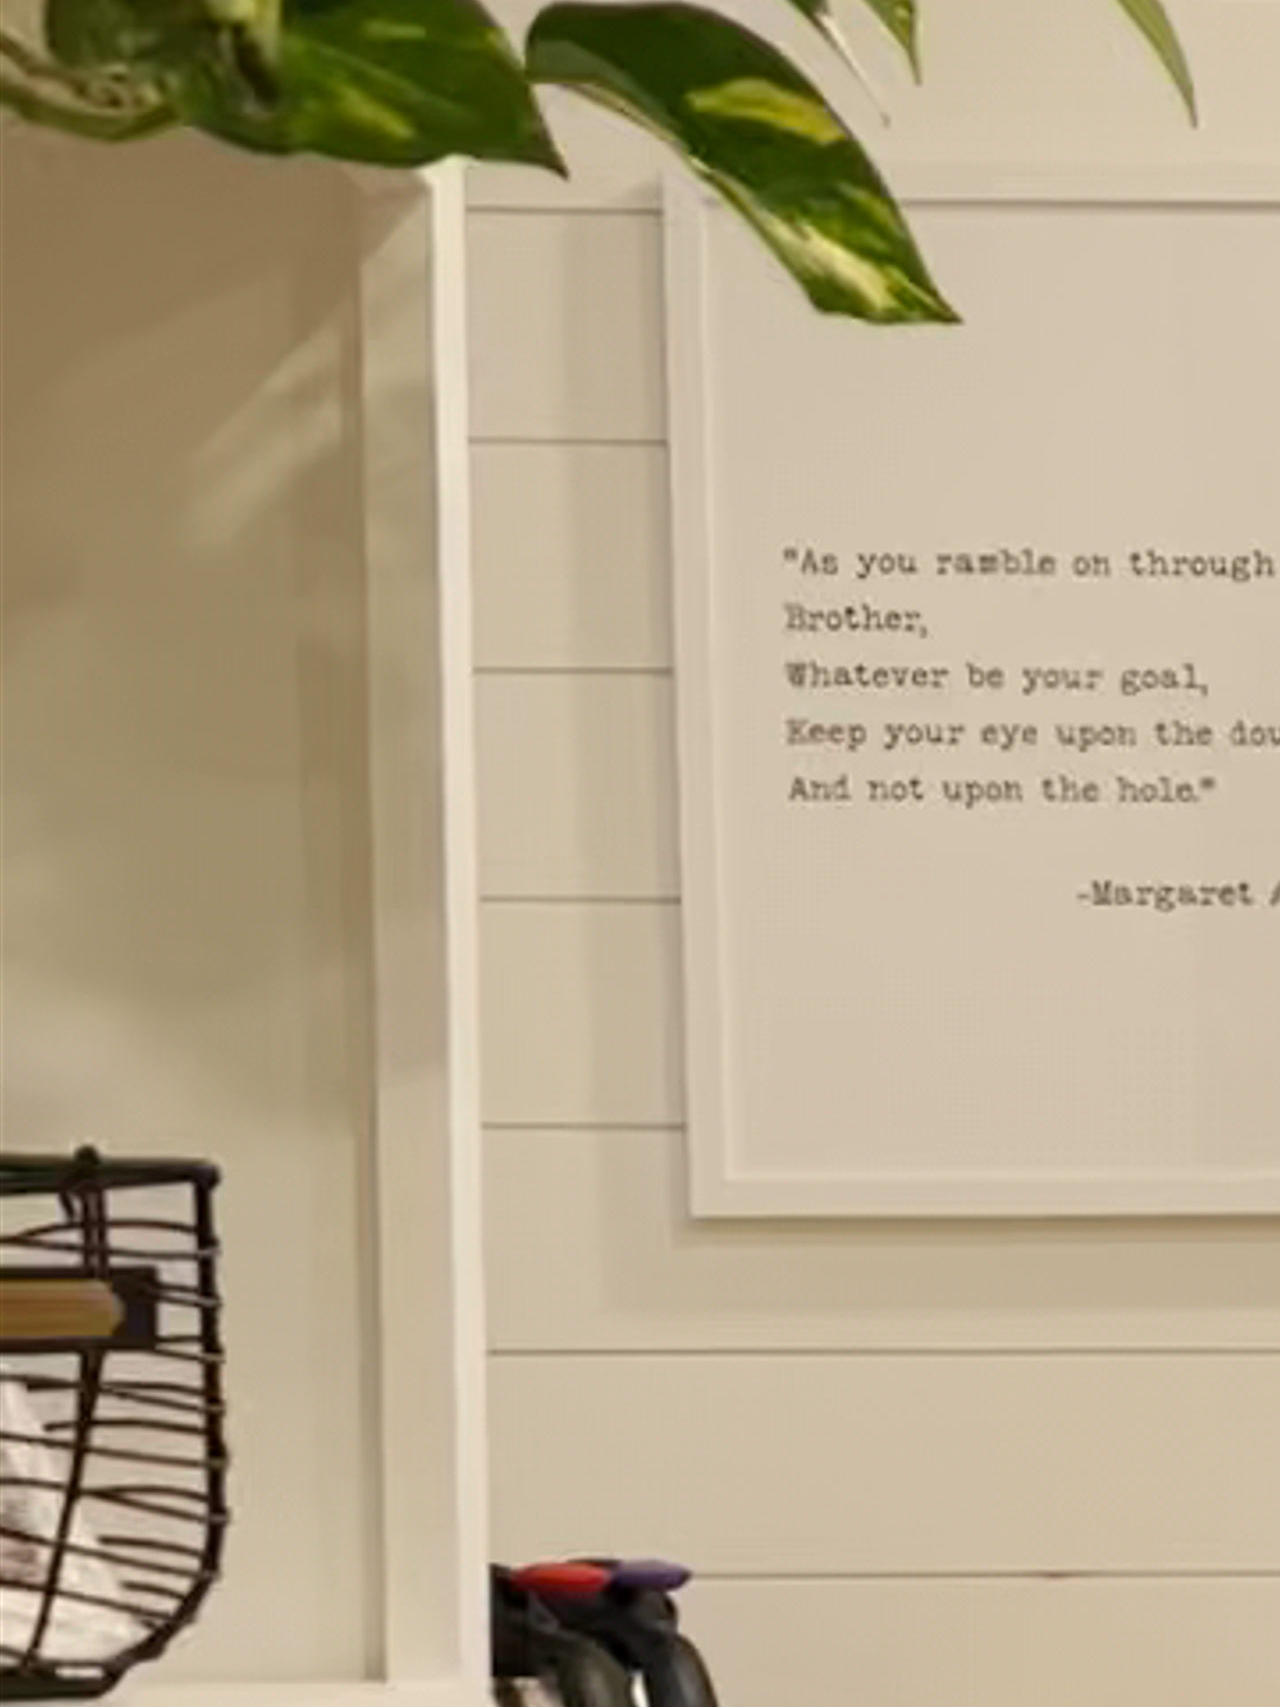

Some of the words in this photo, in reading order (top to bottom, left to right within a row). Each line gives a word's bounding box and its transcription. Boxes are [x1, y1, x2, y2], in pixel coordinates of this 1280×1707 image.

[781, 546, 840, 577] "As
[855, 551, 919, 581] you
[935, 547, 1058, 577] ramble
[1070, 553, 1112, 578] on
[1127, 548, 1277, 584] through
[783, 601, 930, 640] Brother,
[783, 659, 951, 690] Whatever
[964, 661, 1006, 690] be
[1021, 666, 1104, 697] your
[1119, 661, 1210, 698] goal,
[785, 717, 868, 754] Keep
[882, 722, 967, 752] your
[979, 723, 1039, 753] eye
[1054, 723, 1138, 754] upon
[1153, 718, 1214, 747] the
[788, 773, 852, 803] And
[865, 776, 926, 804] not
[941, 778, 1025, 811] upon
[1040, 773, 1100, 804] the
[1076, 878, 1255, 914] -Margaret
